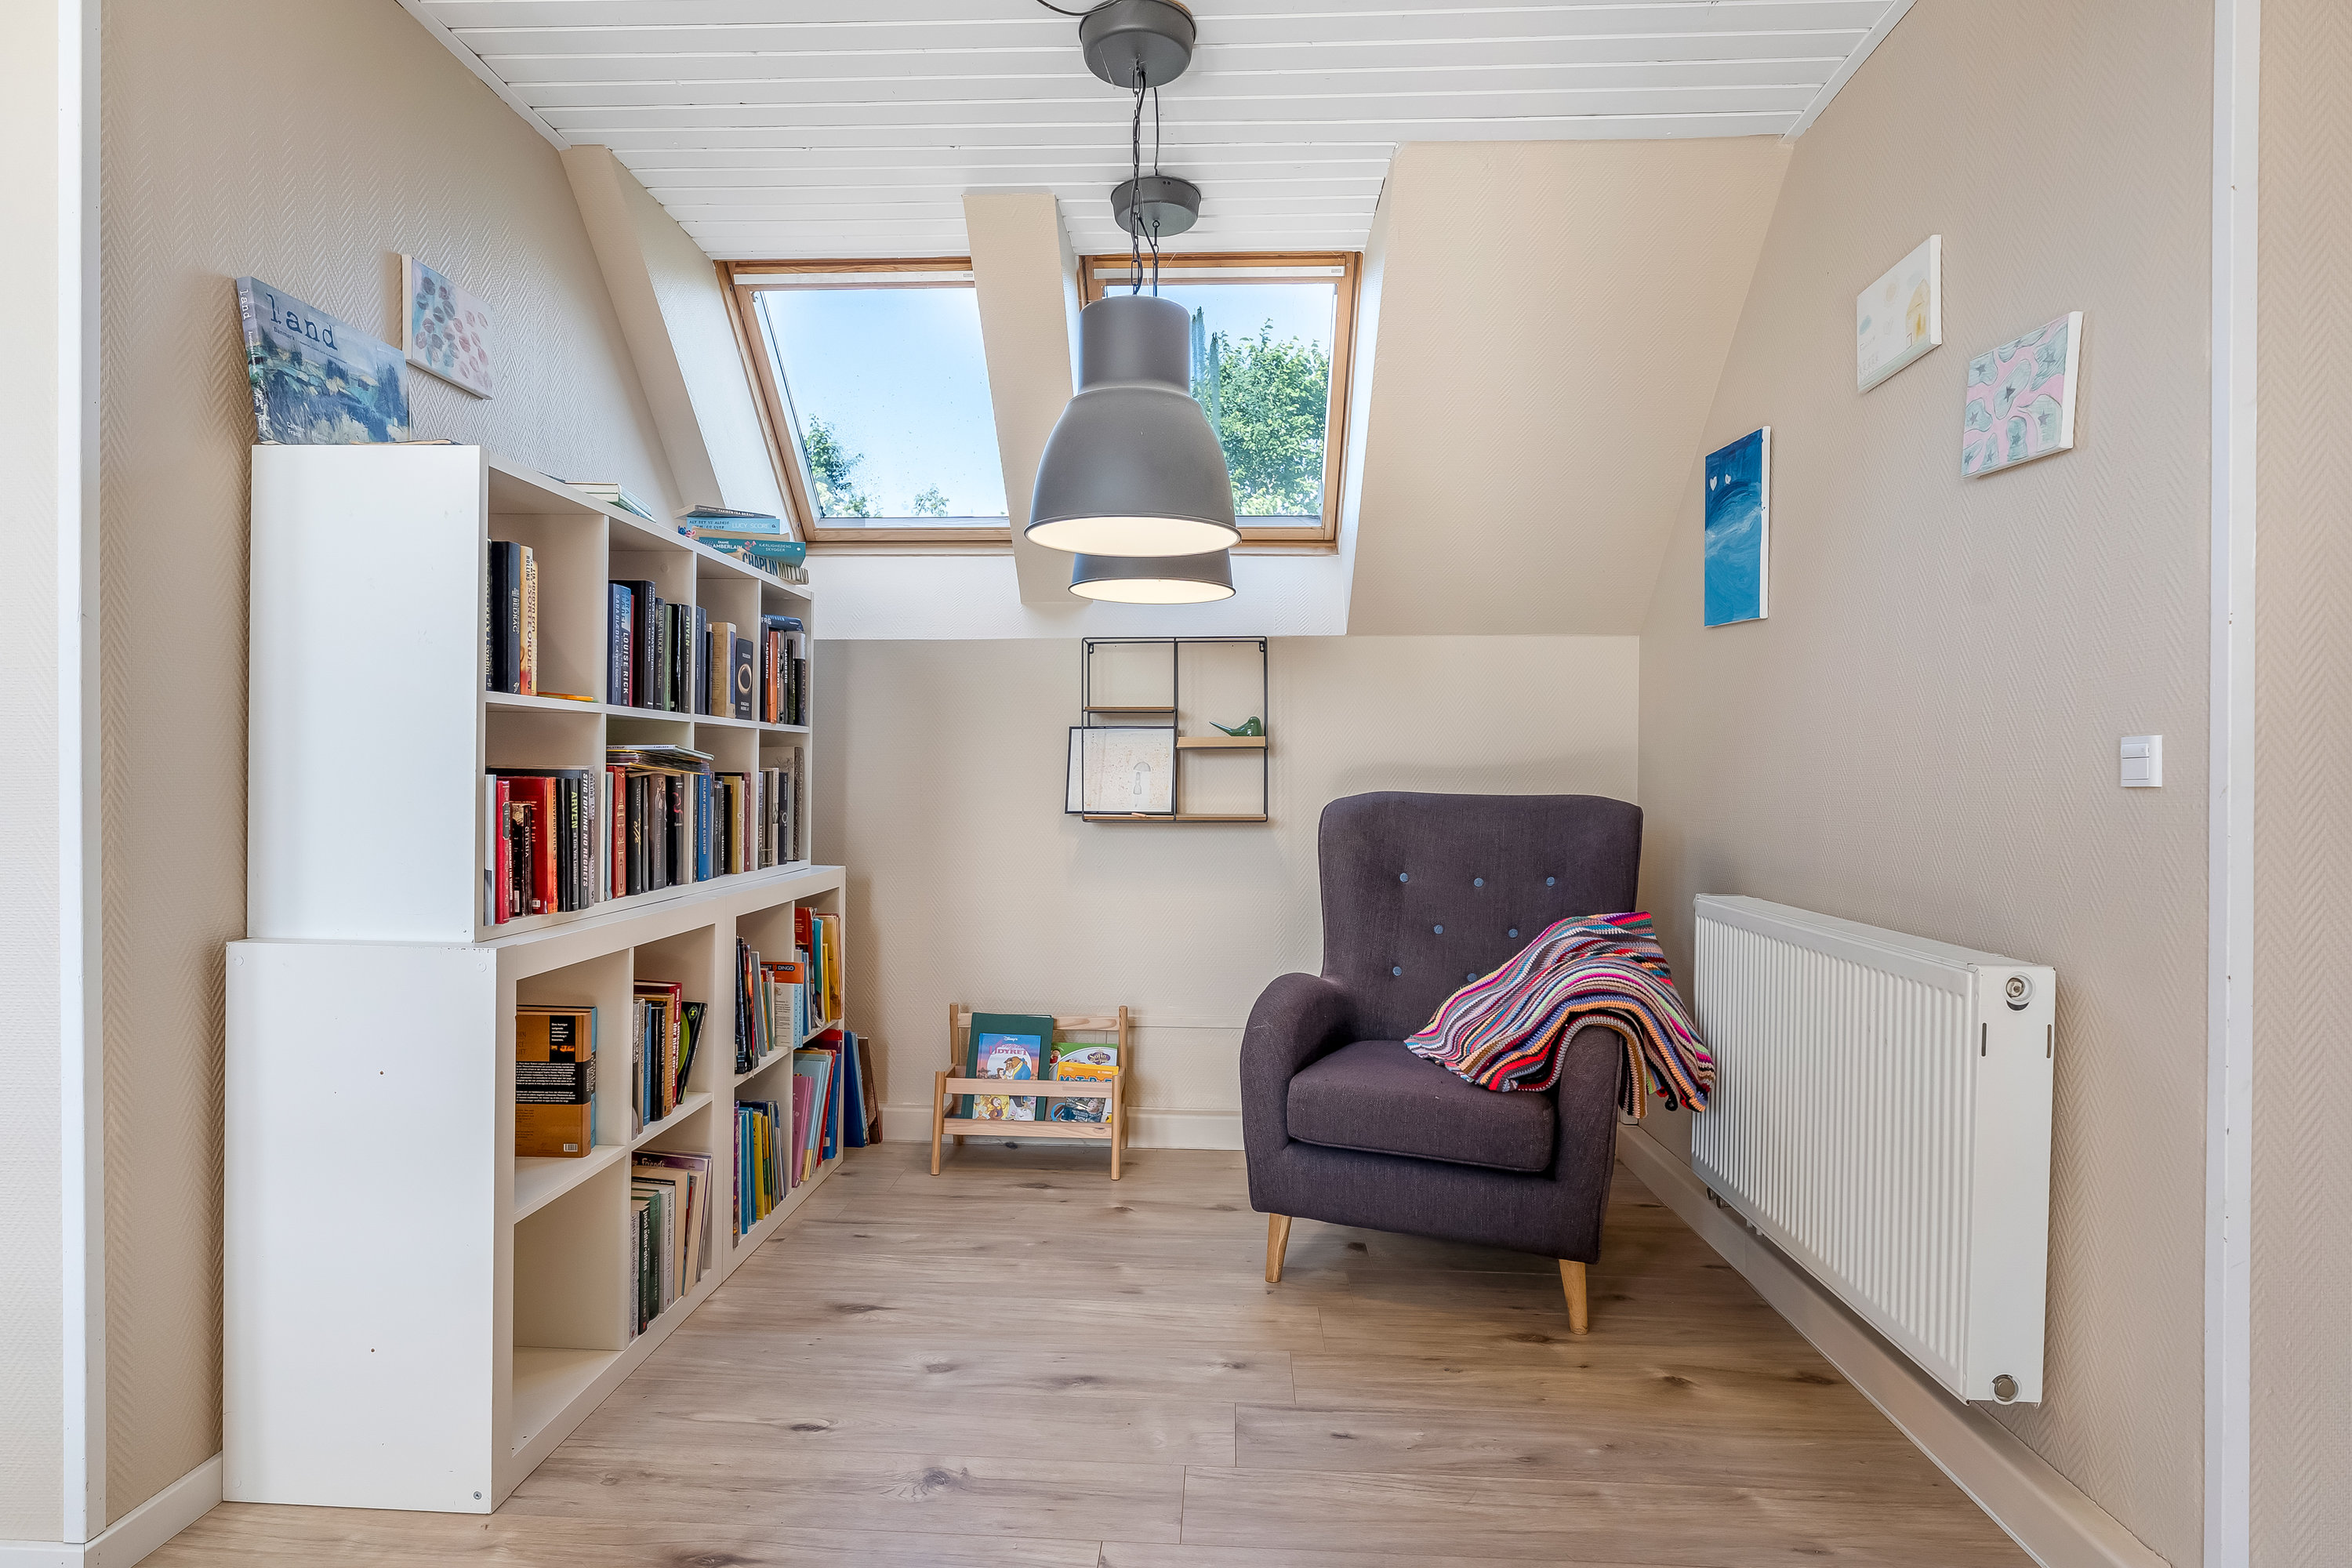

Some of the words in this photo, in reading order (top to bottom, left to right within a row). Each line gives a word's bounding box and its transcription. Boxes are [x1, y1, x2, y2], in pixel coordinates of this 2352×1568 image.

[239, 289, 252, 320] land
[265, 292, 338, 351] land
[742, 553, 779, 577] CHAPLIN
[778, 561, 794, 581] MIT
[583, 833, 588, 846] NO
